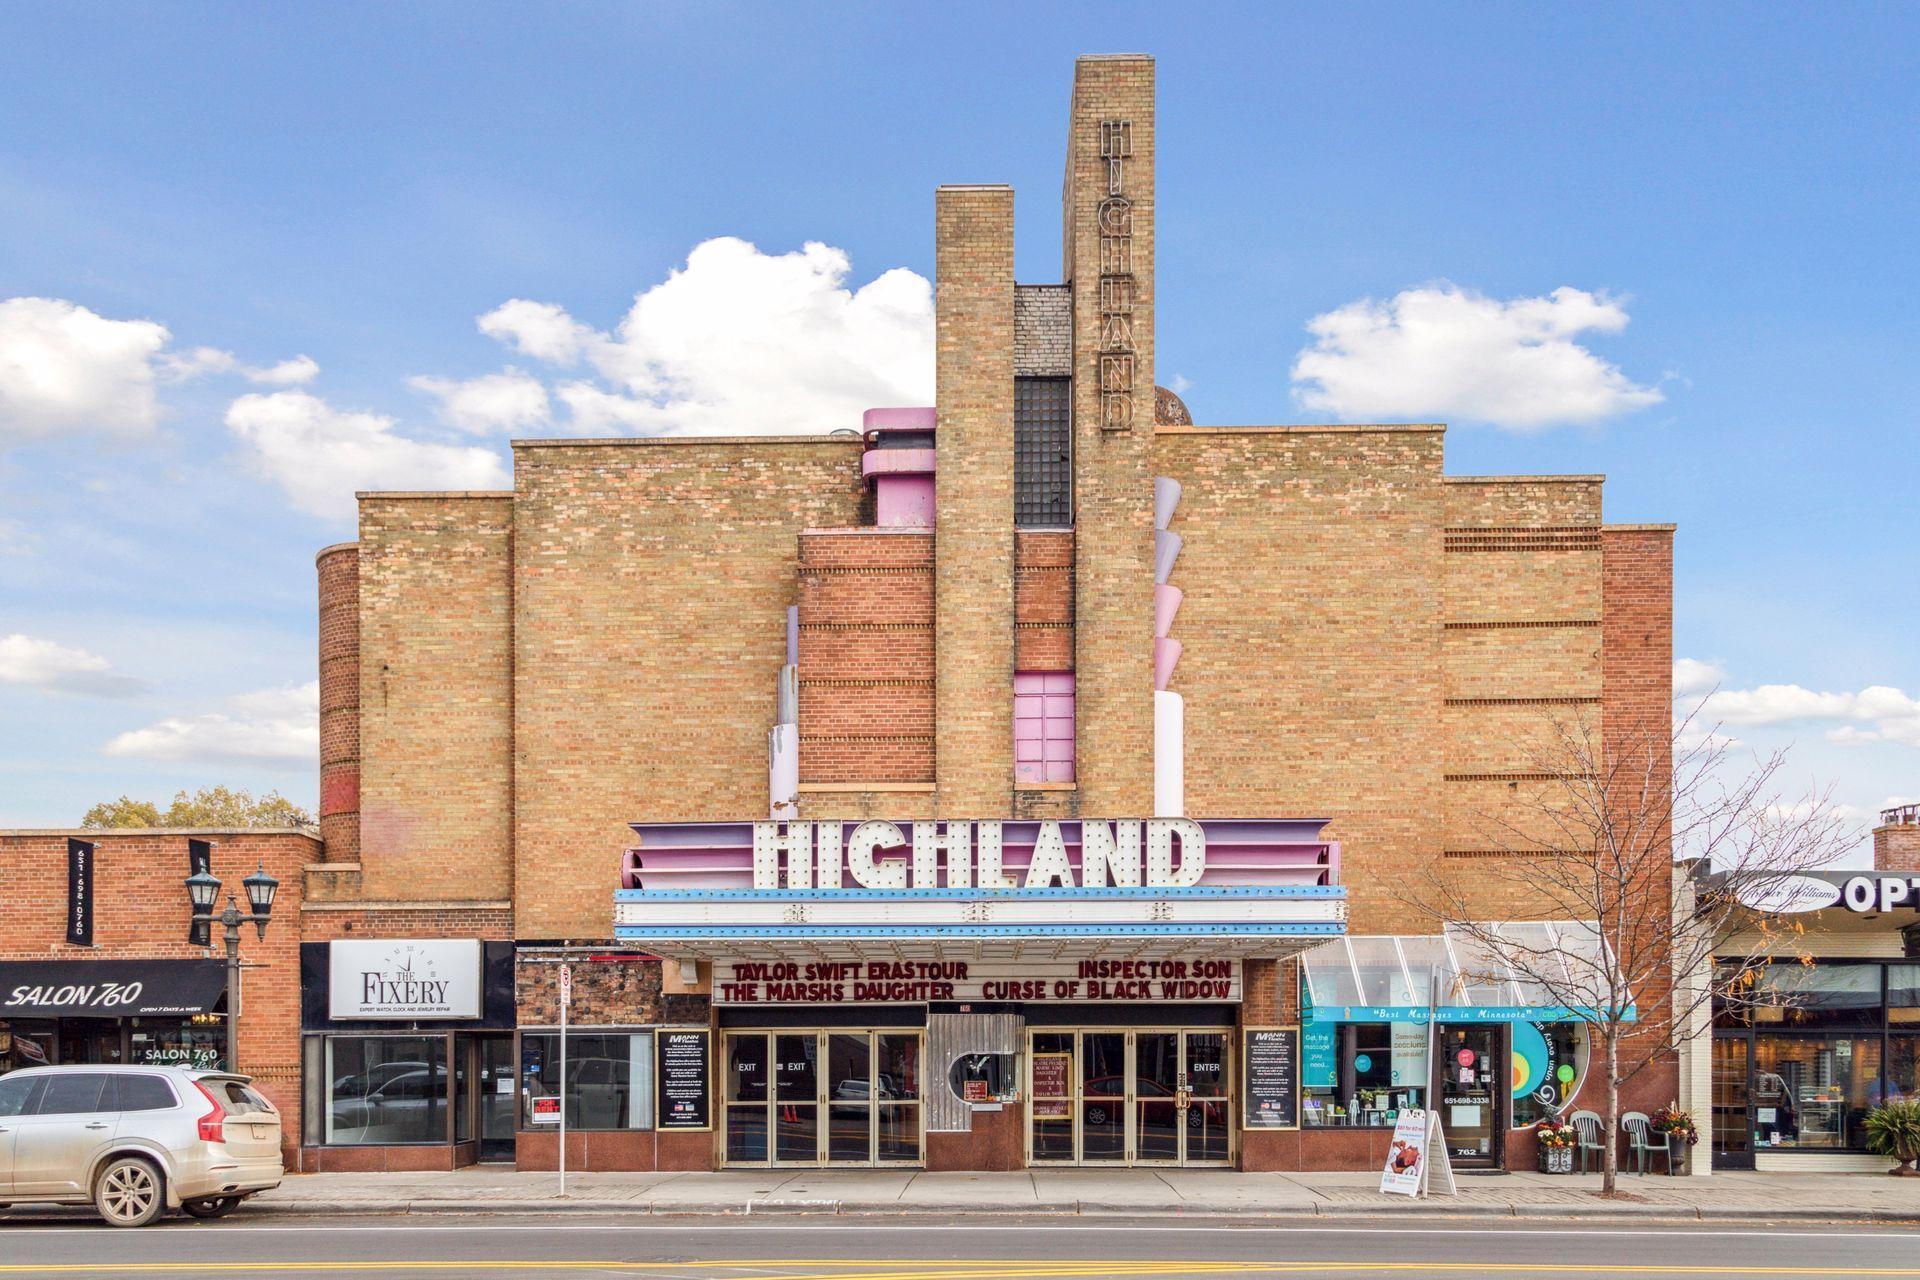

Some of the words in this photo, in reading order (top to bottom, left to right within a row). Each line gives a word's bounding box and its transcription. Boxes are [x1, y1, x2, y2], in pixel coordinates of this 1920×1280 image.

[1098, 119, 1138, 430] HIGHLAND
[753, 818, 1206, 889] HIGHLAND
[1782, 883, 1836, 900] Williams
[396, 971, 415, 981] THE
[732, 962, 799, 982] TAYLOR
[805, 962, 863, 982] SWIFT
[1078, 960, 1188, 980] INSPECTOR
[1191, 960, 1232, 979] SON
[4, 985, 96, 1006] SALON
[90, 982, 143, 1006] 760
[360, 971, 450, 1004] FIXERY
[720, 983, 758, 1002] THE
[766, 983, 845, 1002] MARSHS
[853, 982, 955, 1001] DAUGHTER
[982, 981, 1047, 1000] CURSE
[1054, 980, 1080, 1000] OF
[1087, 980, 1153, 1000] BLACK
[1161, 980, 1232, 1000] WIDOW
[1460, 1009, 1470, 1019] in
[669, 1034, 699, 1043] MANN
[1255, 1032, 1286, 1041] MANN
[145, 1049, 190, 1060] SALON
[193, 1049, 218, 1062] 760
[738, 1063, 756, 1072] EXIT
[788, 1062, 806, 1071] EXIT
[1193, 1063, 1220, 1072] ENTER
[534, 1105, 560, 1113] RENT
[537, 1099, 555, 1107] FOR
